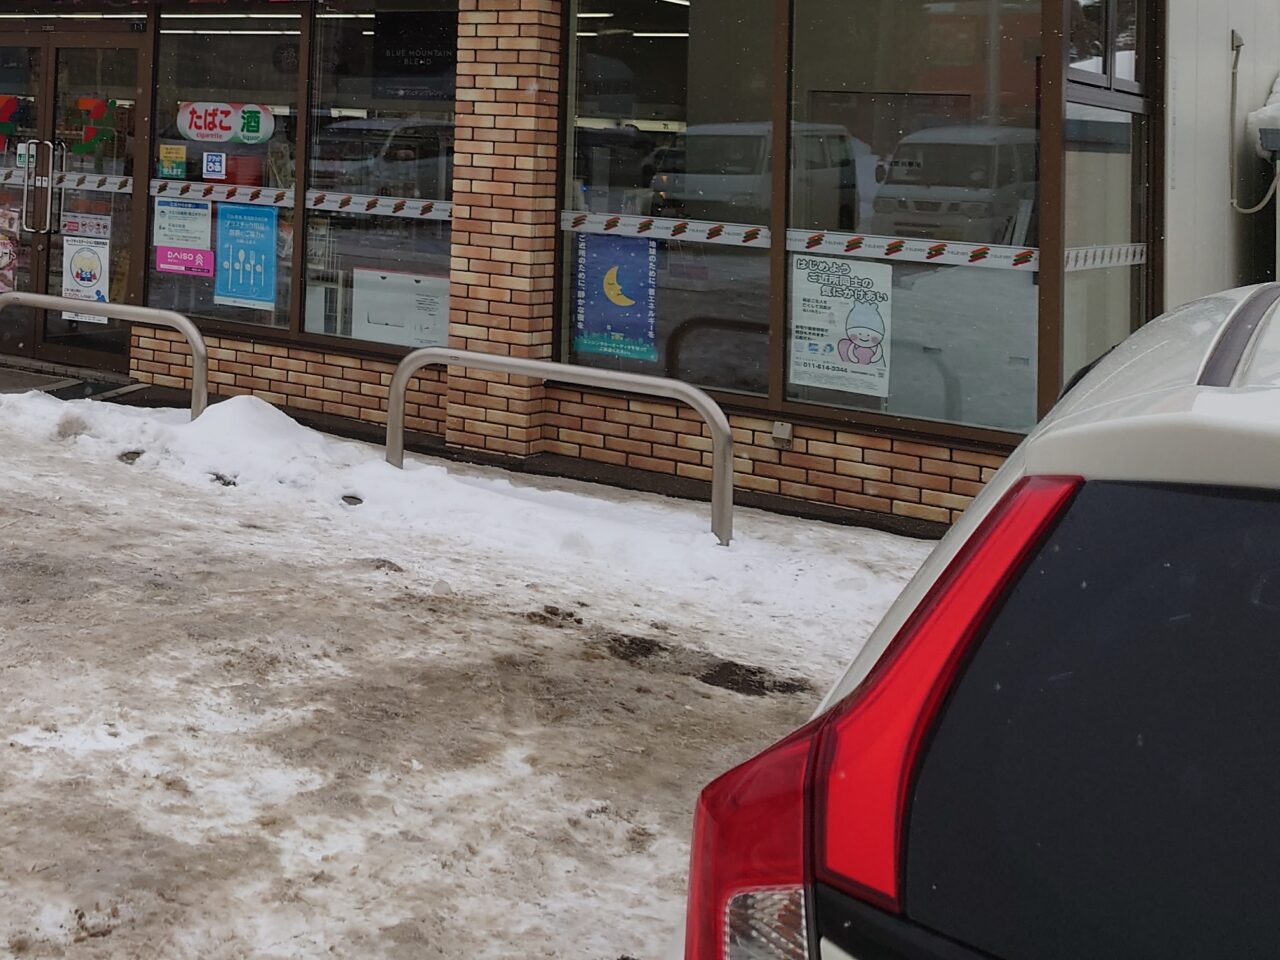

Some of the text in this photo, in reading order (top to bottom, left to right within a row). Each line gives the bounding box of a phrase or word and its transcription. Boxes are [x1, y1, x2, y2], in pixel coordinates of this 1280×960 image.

[188, 107, 261, 133] たばこ 酒
[167, 251, 193, 261] DAISO
[796, 258, 851, 274] はじめよう
[807, 271, 873, 289] ご近所同士の
[820, 285, 888, 302] 気にかけあい
